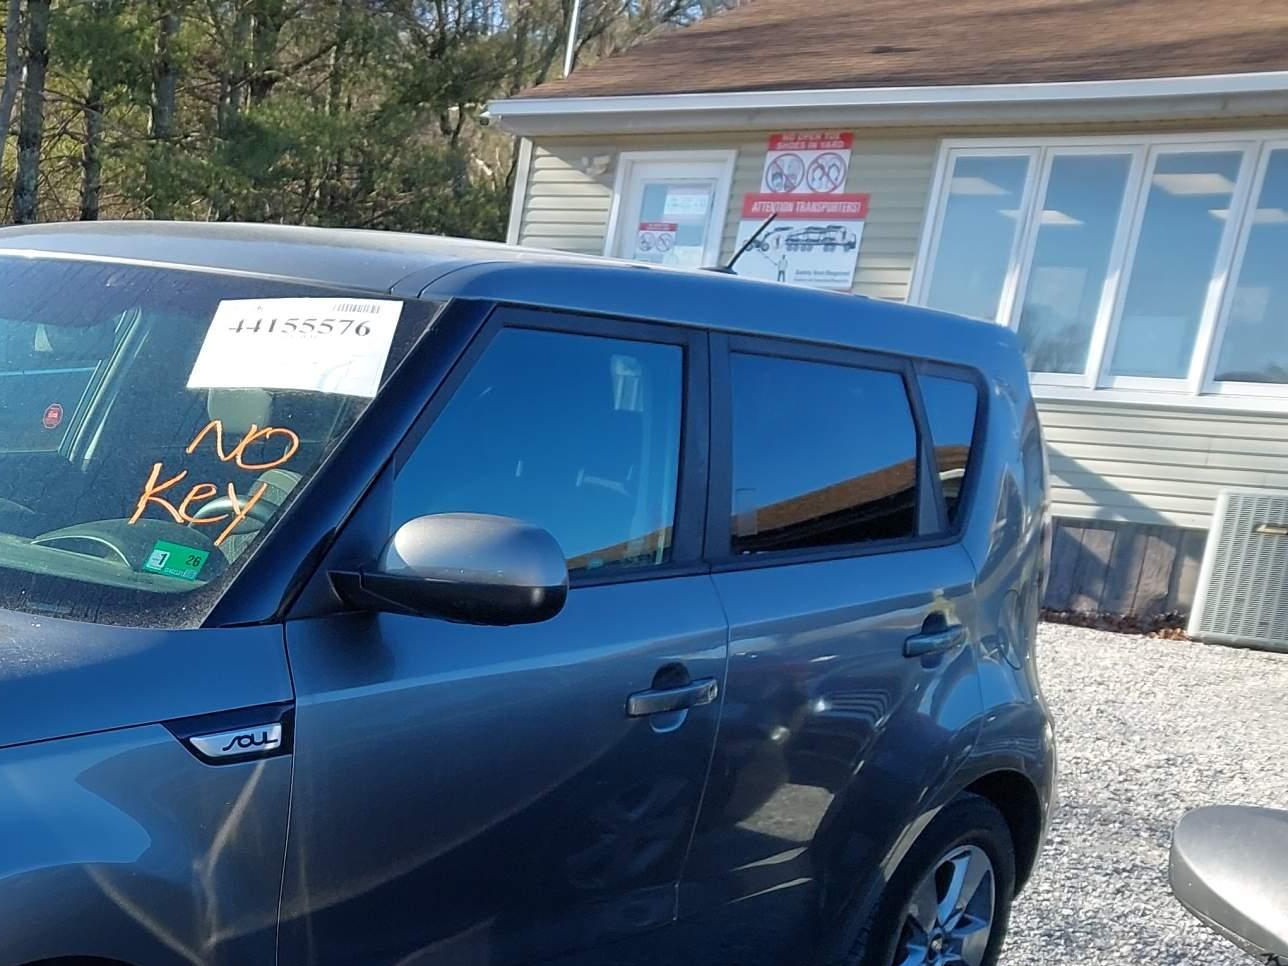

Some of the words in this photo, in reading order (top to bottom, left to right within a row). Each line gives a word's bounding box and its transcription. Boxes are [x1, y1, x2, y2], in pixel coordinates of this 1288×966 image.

[751, 201, 793, 213] ATTENTION
[228, 317, 372, 337] 44155576
[186, 419, 300, 470] NO
[185, 554, 202, 567] 26
